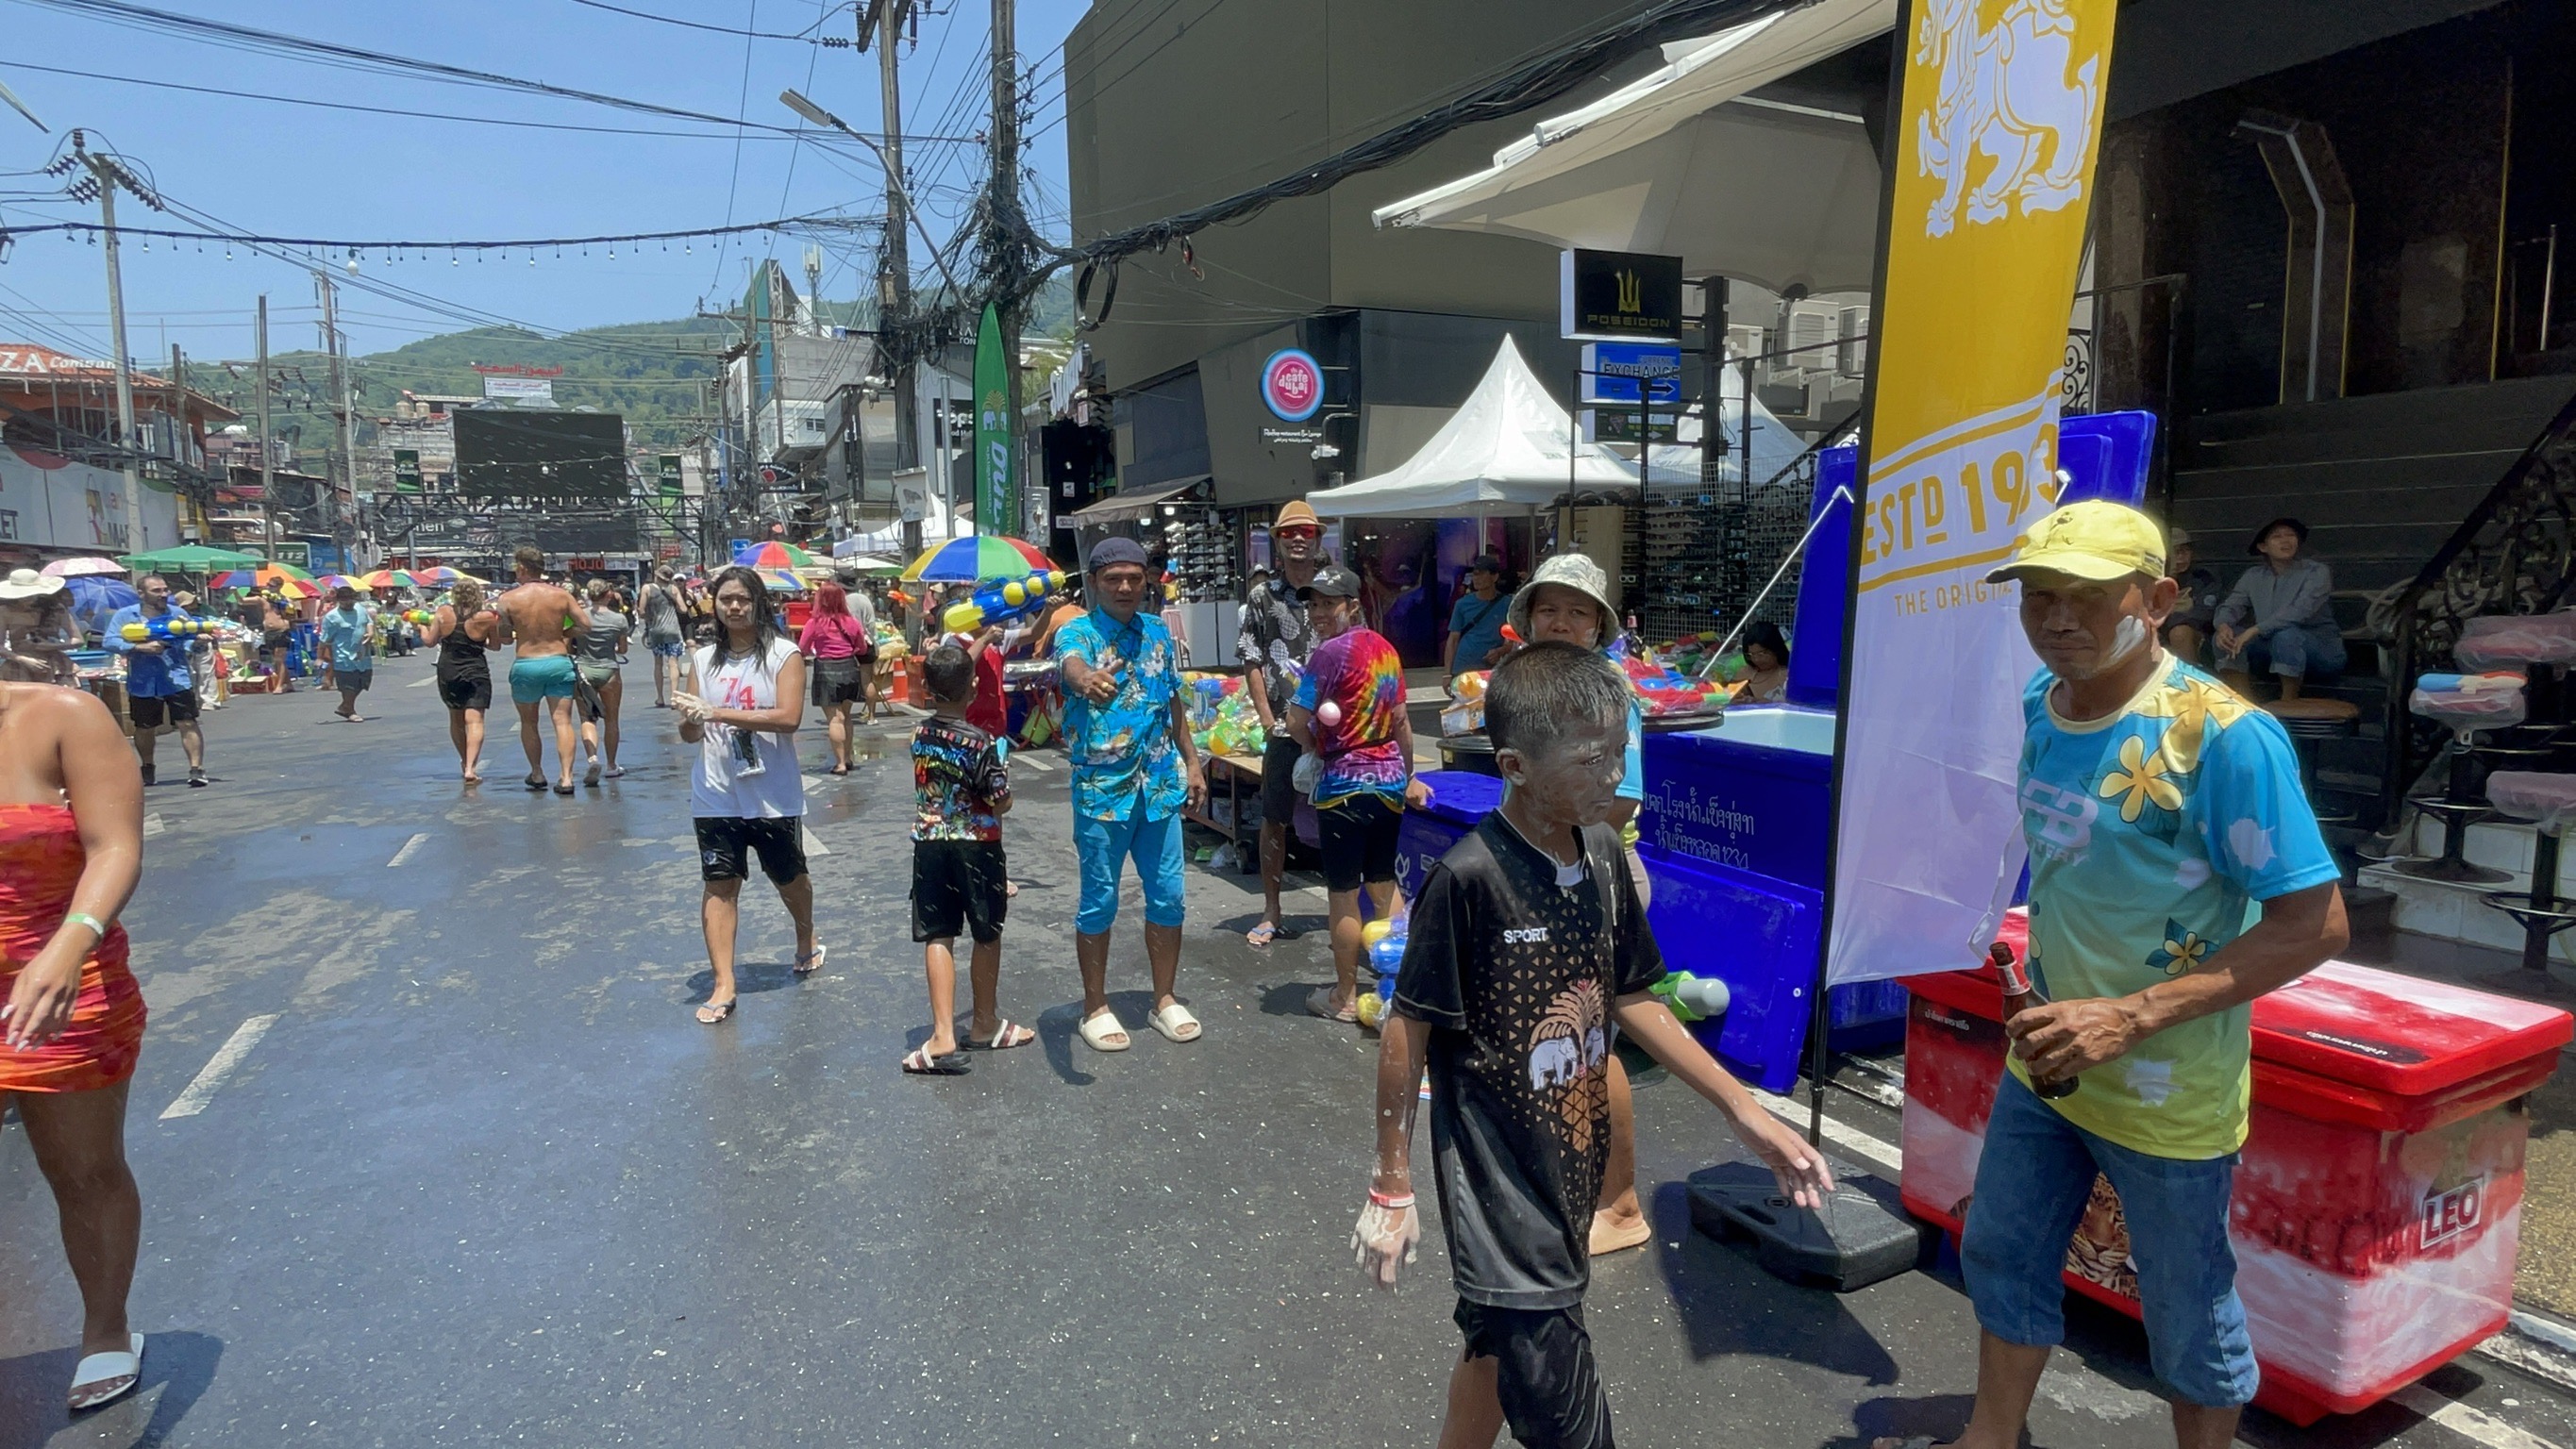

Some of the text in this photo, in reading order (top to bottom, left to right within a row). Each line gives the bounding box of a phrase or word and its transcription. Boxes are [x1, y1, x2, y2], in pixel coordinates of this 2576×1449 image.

[1587, 314, 1670, 327] POSEIDON
[1286, 369, 1309, 383] cafe
[1603, 363, 1681, 380] EXCHANGE
[1279, 375, 1308, 395] dubai
[1895, 590, 1928, 617] THE
[1503, 927, 1547, 943] SPORT
[2423, 1183, 2480, 1243] LEO
